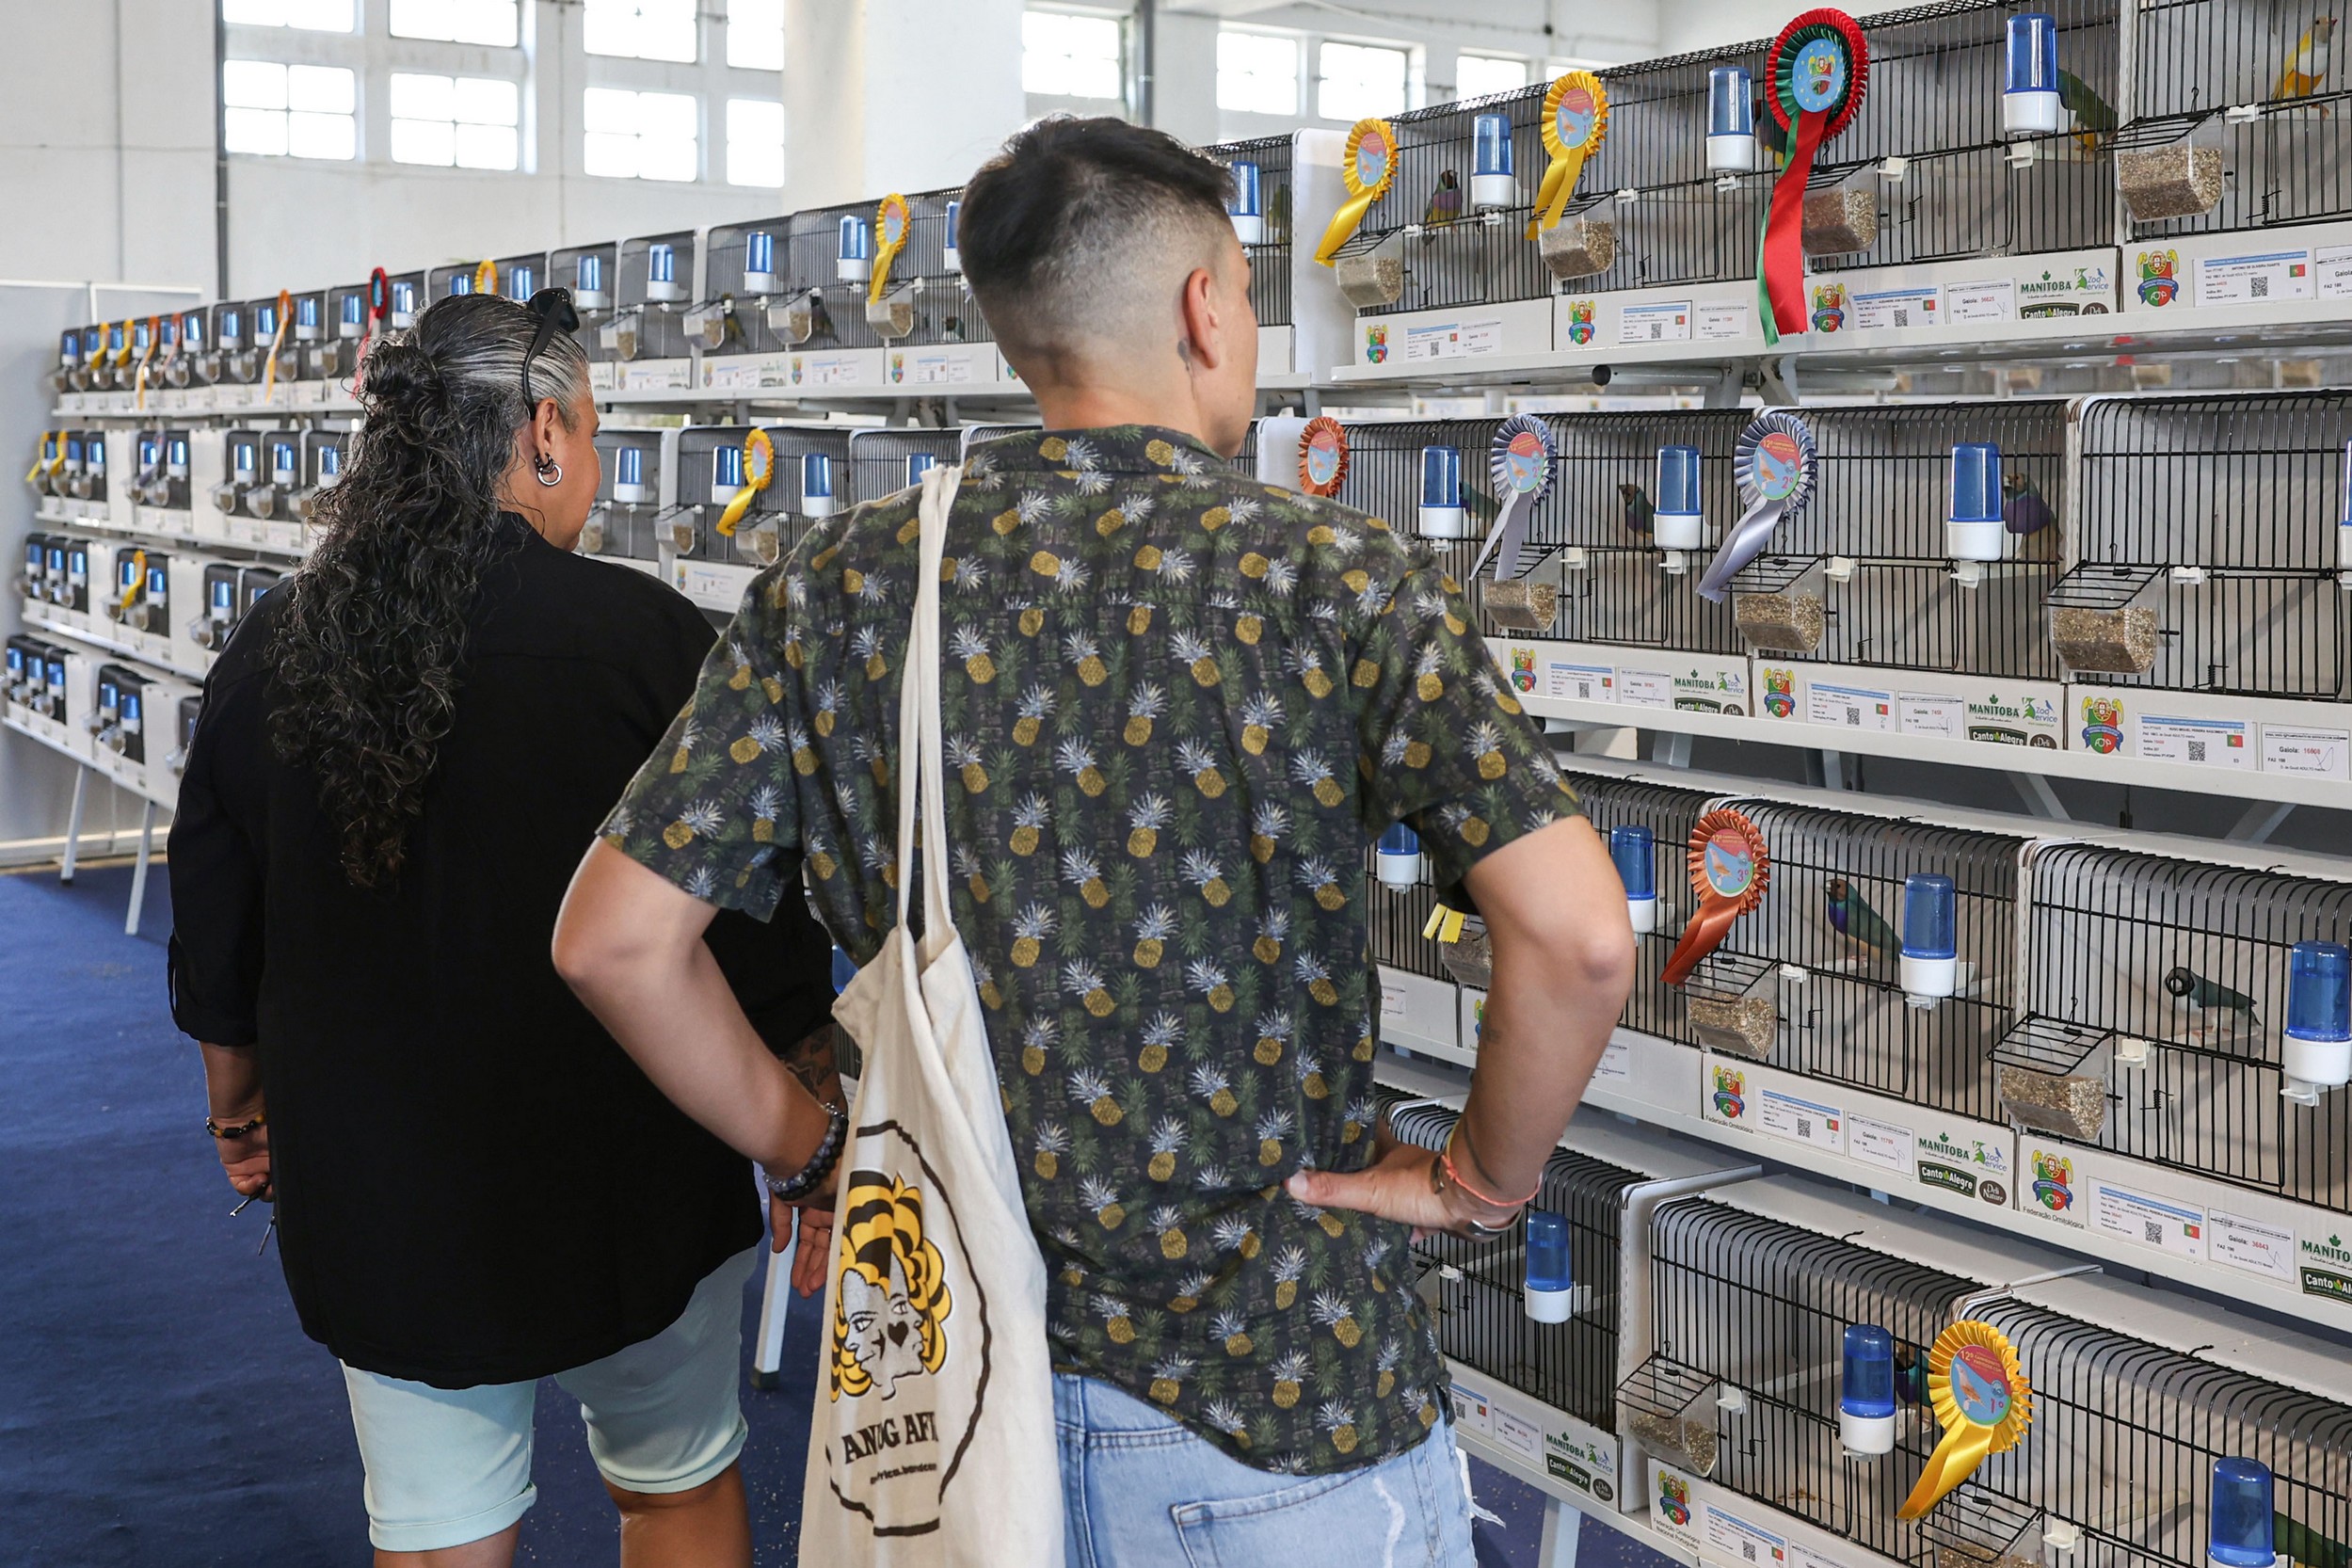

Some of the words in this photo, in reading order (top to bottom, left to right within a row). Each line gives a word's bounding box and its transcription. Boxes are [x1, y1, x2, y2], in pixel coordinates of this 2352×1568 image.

[2021, 281, 2072, 294] MANITOBA
[2024, 311, 2046, 319] Canto
[1782, 476, 1794, 489] 2º
[1674, 678, 1715, 690] MANITOBA
[1969, 703, 2020, 717] MANITOBA
[2036, 707, 2050, 715] Zoo
[1973, 731, 1994, 741] Canto
[2000, 734, 2024, 745] Alegre
[1737, 869, 1750, 883] 3º
[1919, 1138, 1970, 1160] MANITOBA
[1986, 1153, 2000, 1162] Zoo
[1922, 1167, 1944, 1179] Canto
[1949, 1173, 1973, 1190] Alegre
[1983, 1189, 2004, 1202] Nature
[1987, 1184, 2000, 1194] Deli
[2228, 1235, 2248, 1245] Gaiola:
[2301, 1240, 2352, 1265] MANITO
[2306, 1273, 2334, 1289] Canto
[2342, 1282, 2352, 1295] Al
[1960, 1351, 1975, 1362] 12º
[1991, 1398, 2004, 1414] 1º
[1546, 1434, 1585, 1460] MANITOBA
